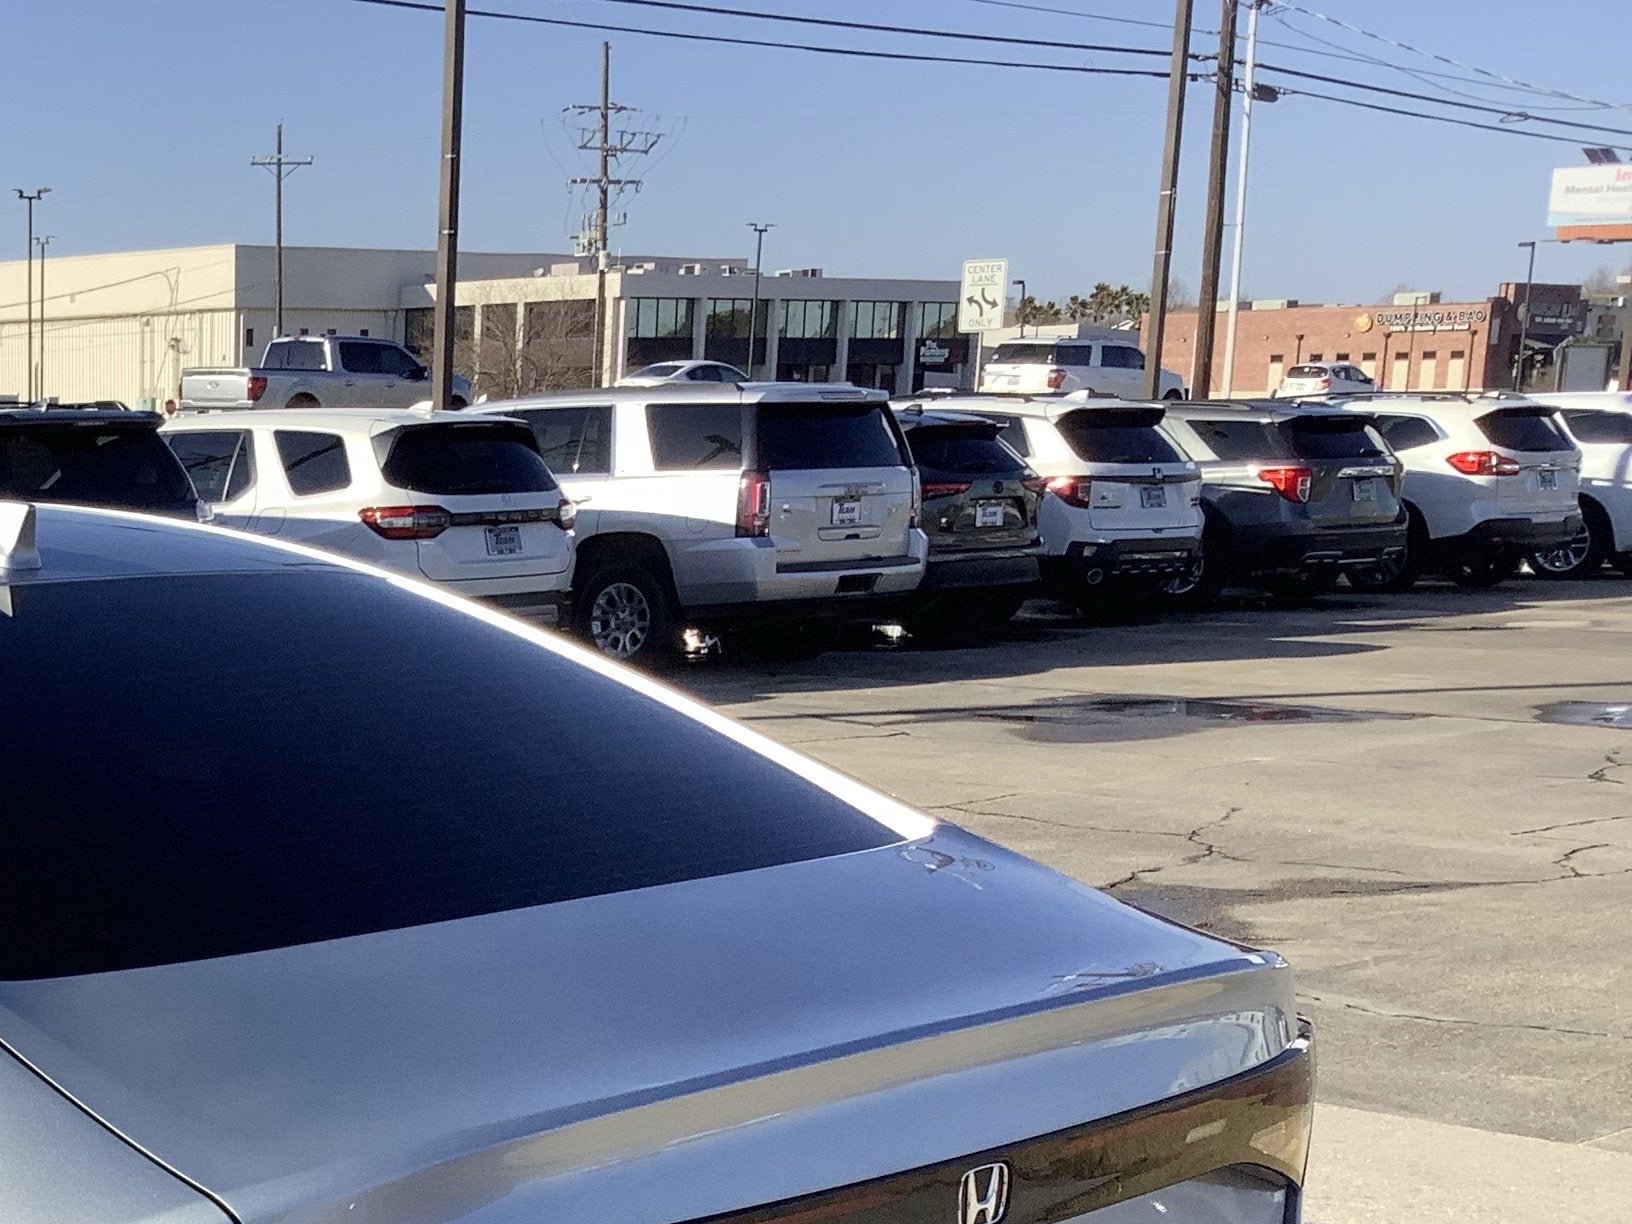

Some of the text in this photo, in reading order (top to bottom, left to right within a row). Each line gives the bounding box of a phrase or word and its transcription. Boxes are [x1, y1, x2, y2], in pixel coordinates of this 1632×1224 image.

[967, 264, 1003, 274] CENTER
[972, 274, 997, 283] LANE
[1458, 309, 1486, 322] BAO
[968, 318, 993, 328] ONLY
